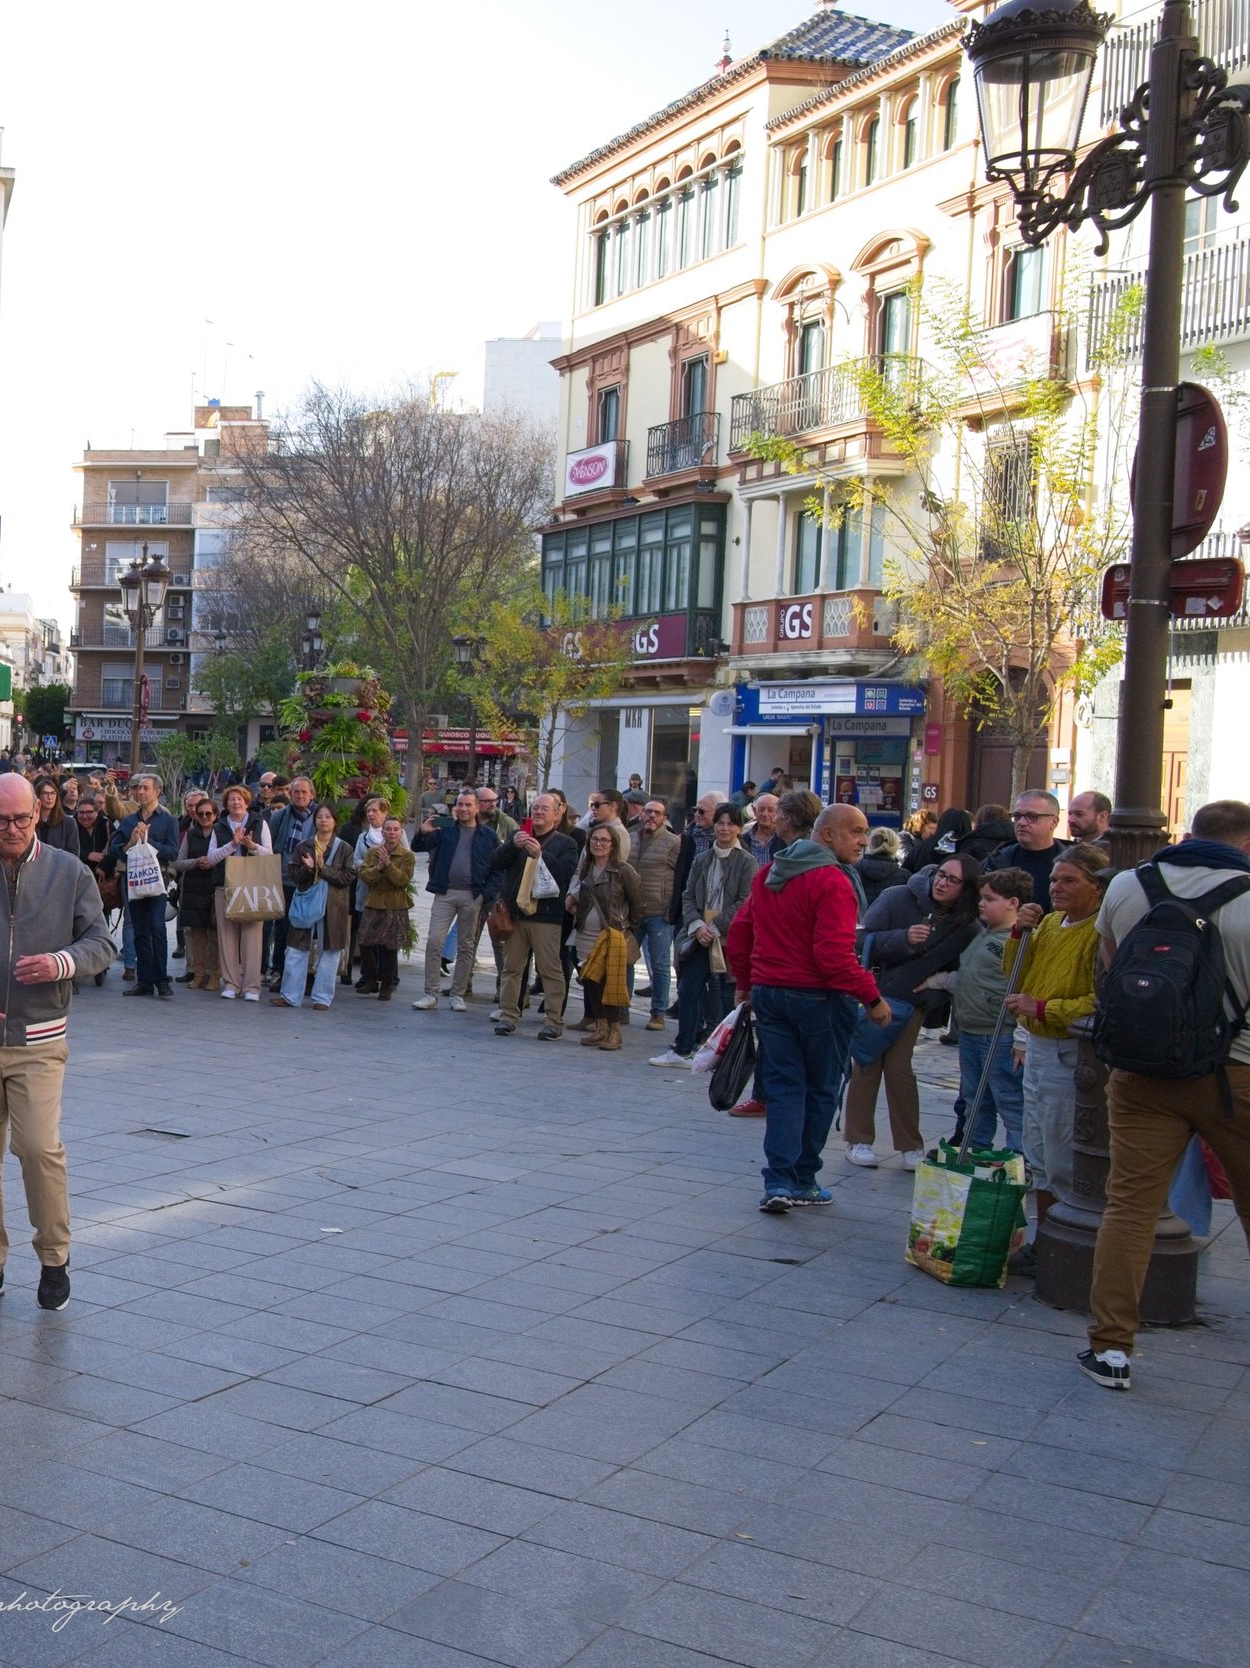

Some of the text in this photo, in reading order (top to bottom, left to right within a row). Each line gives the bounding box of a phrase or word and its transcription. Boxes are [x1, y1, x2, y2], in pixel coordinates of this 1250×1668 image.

[571, 458, 607, 481] SVENSON
[784, 603, 813, 639] GS
[635, 624, 659, 654] GS
[767, 688, 776, 699] La
[778, 687, 816, 702] Campana
[80, 718, 104, 728] BAR
[832, 720, 887, 733] La Campana
[924, 786, 937, 799] GS
[225, 885, 284, 913] ZARA
